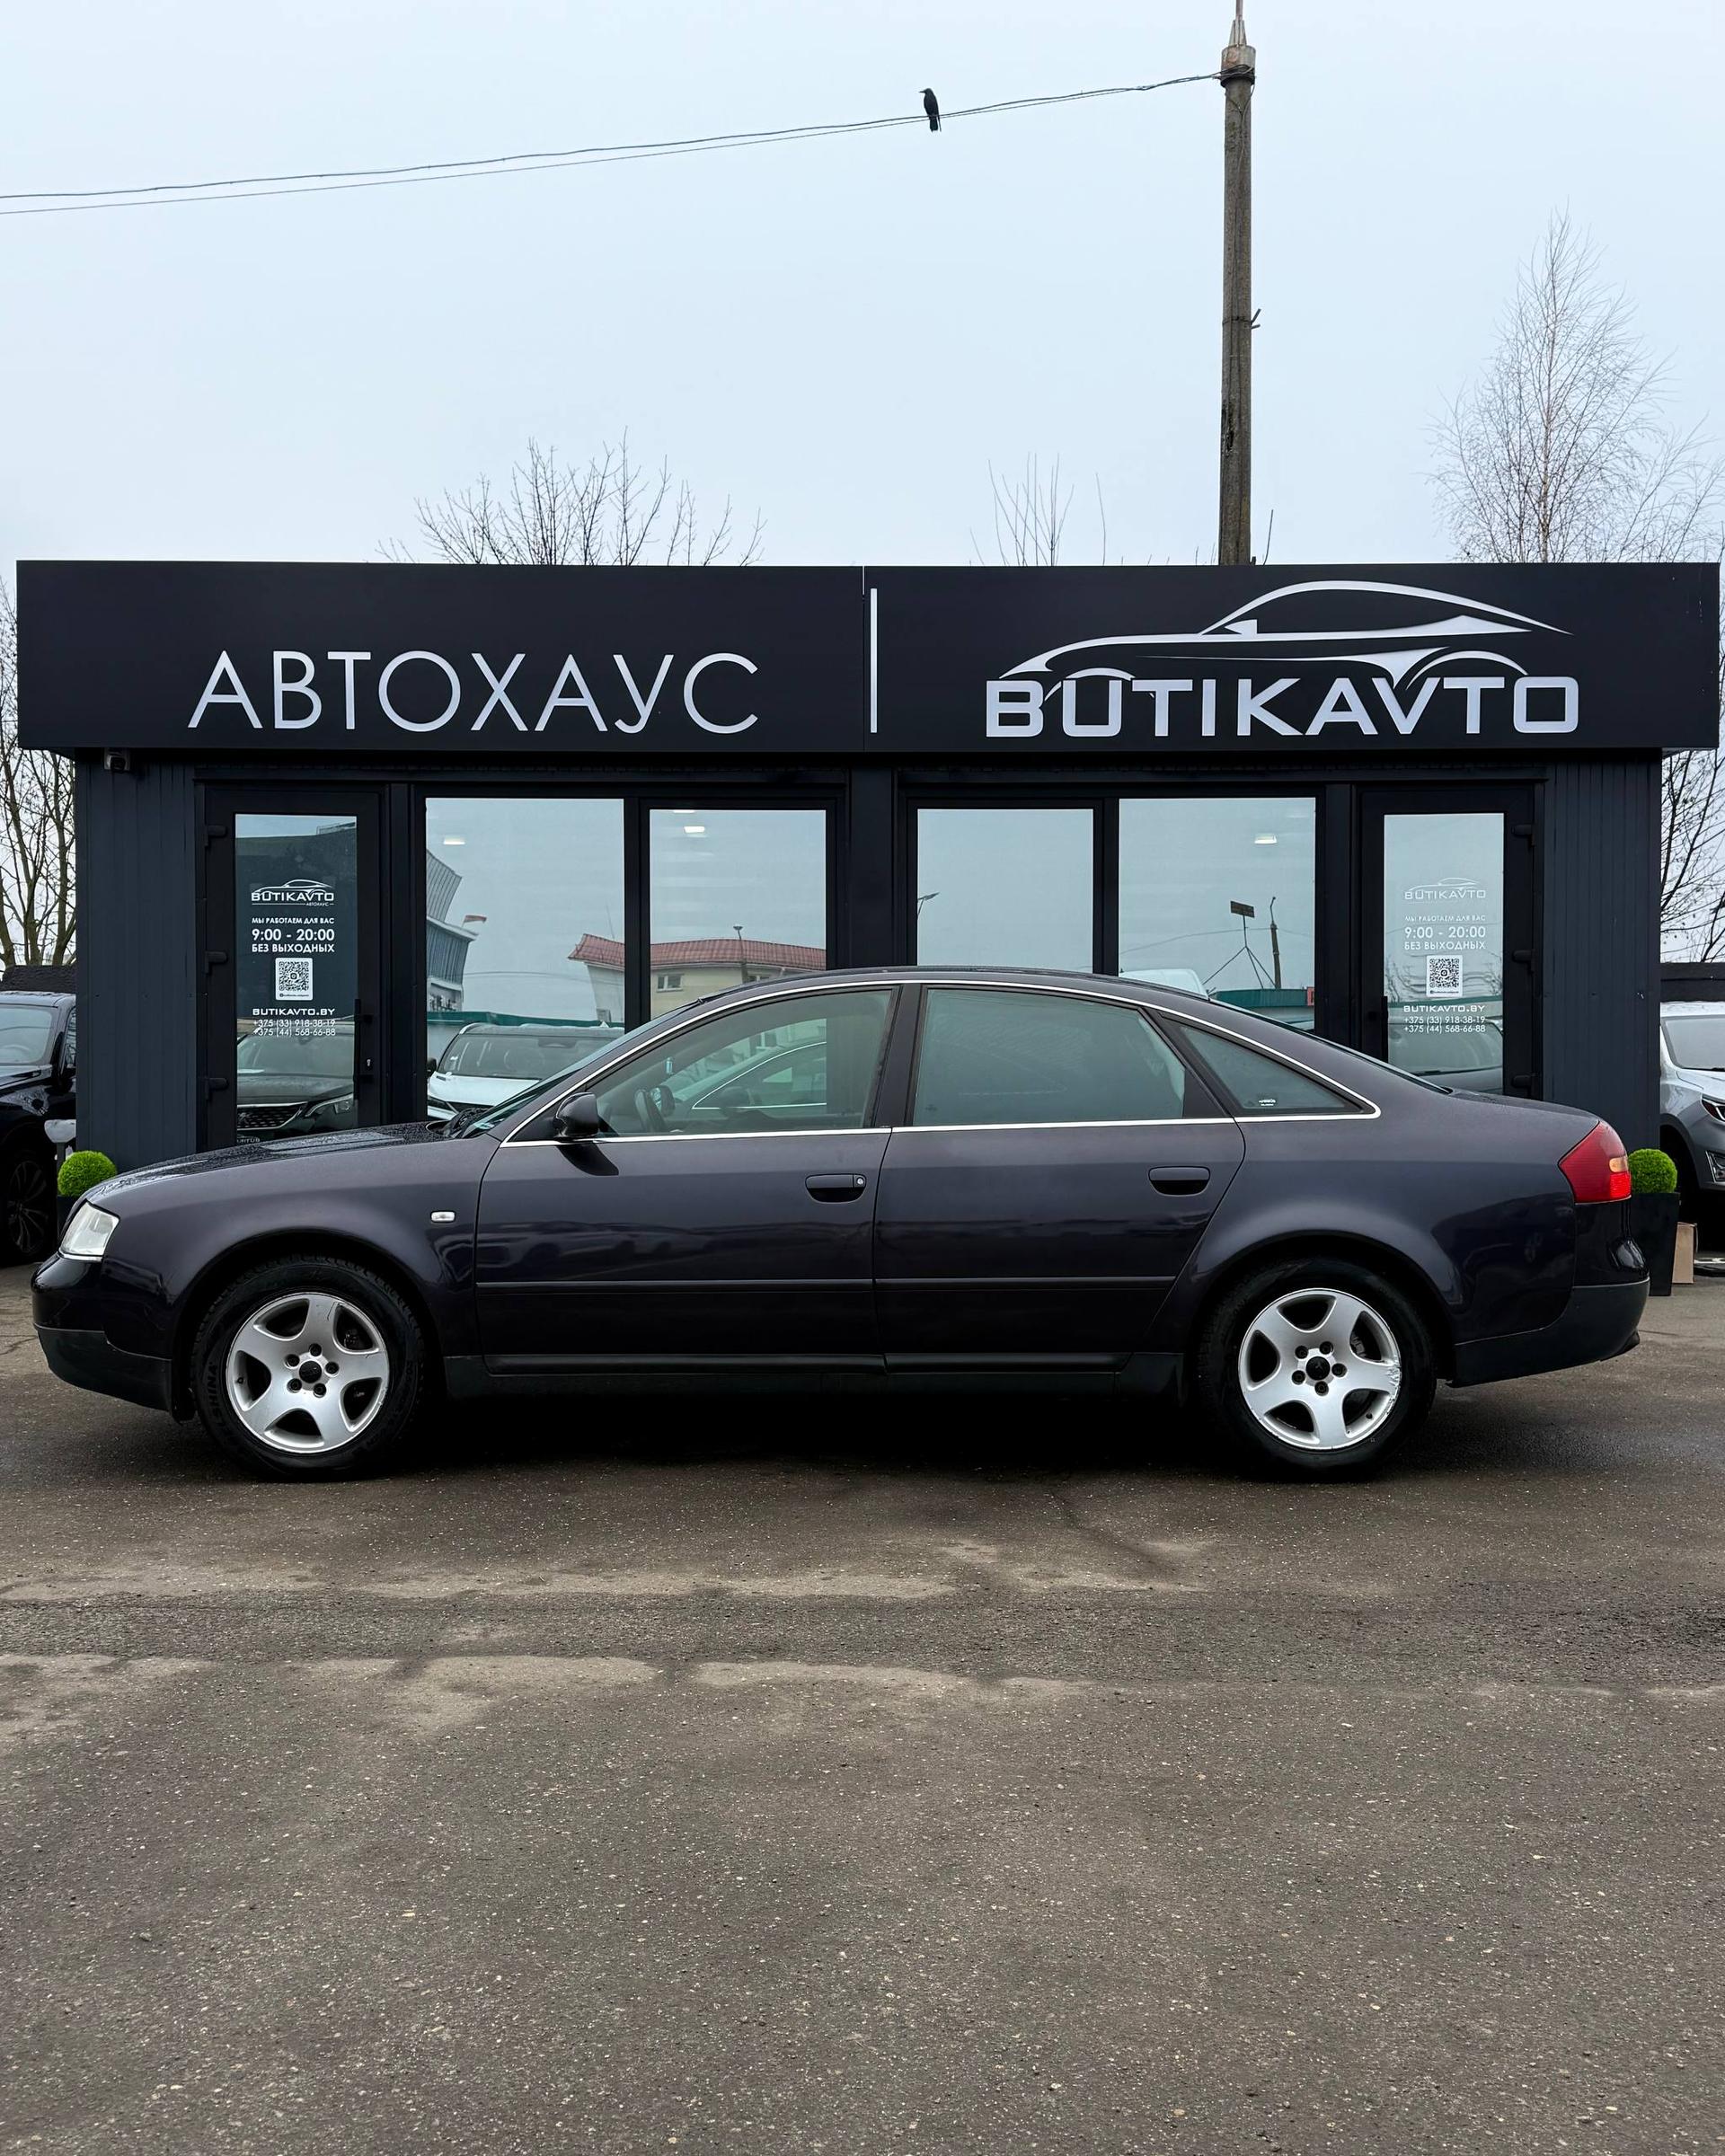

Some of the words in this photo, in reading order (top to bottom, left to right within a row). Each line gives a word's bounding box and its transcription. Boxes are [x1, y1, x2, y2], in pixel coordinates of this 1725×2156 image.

[188, 649, 758, 734] АВТОХАУС
[986, 676, 1579, 738] BUTIKAVTO
[252, 892, 334, 901] BUTIKAVTO
[1404, 890, 1486, 899] BUTIKAVTO
[252, 928, 281, 941] 9:00
[296, 928, 335, 941] 20:00
[1404, 926, 1434, 939] 9:00
[1448, 926, 1486, 939] 20:00
[252, 943, 269, 952] БЕЗ
[272, 943, 335, 953] ВЫХОДНЫХ
[1404, 941, 1420, 950] БЕЗ
[1424, 941, 1486, 950] ВЫХОДНЫХ
[252, 1008, 335, 1016] BUTIKAVTO.BY
[253, 1019, 274, 1028] +375
[276, 1019, 292, 1029] (33)
[294, 1019, 336, 1028] 918-38-19
[1403, 1016, 1424, 1024] +375
[1426, 1016, 1442, 1025] (33)
[1445, 1016, 1486, 1024] 918-38-19
[276, 1028, 292, 1037] (44)
[295, 1028, 336, 1036] 568-66-88
[1403, 1025, 1424, 1033] +375
[1426, 1024, 1442, 1034] (44)
[1445, 1025, 1486, 1033] 568-66-88
